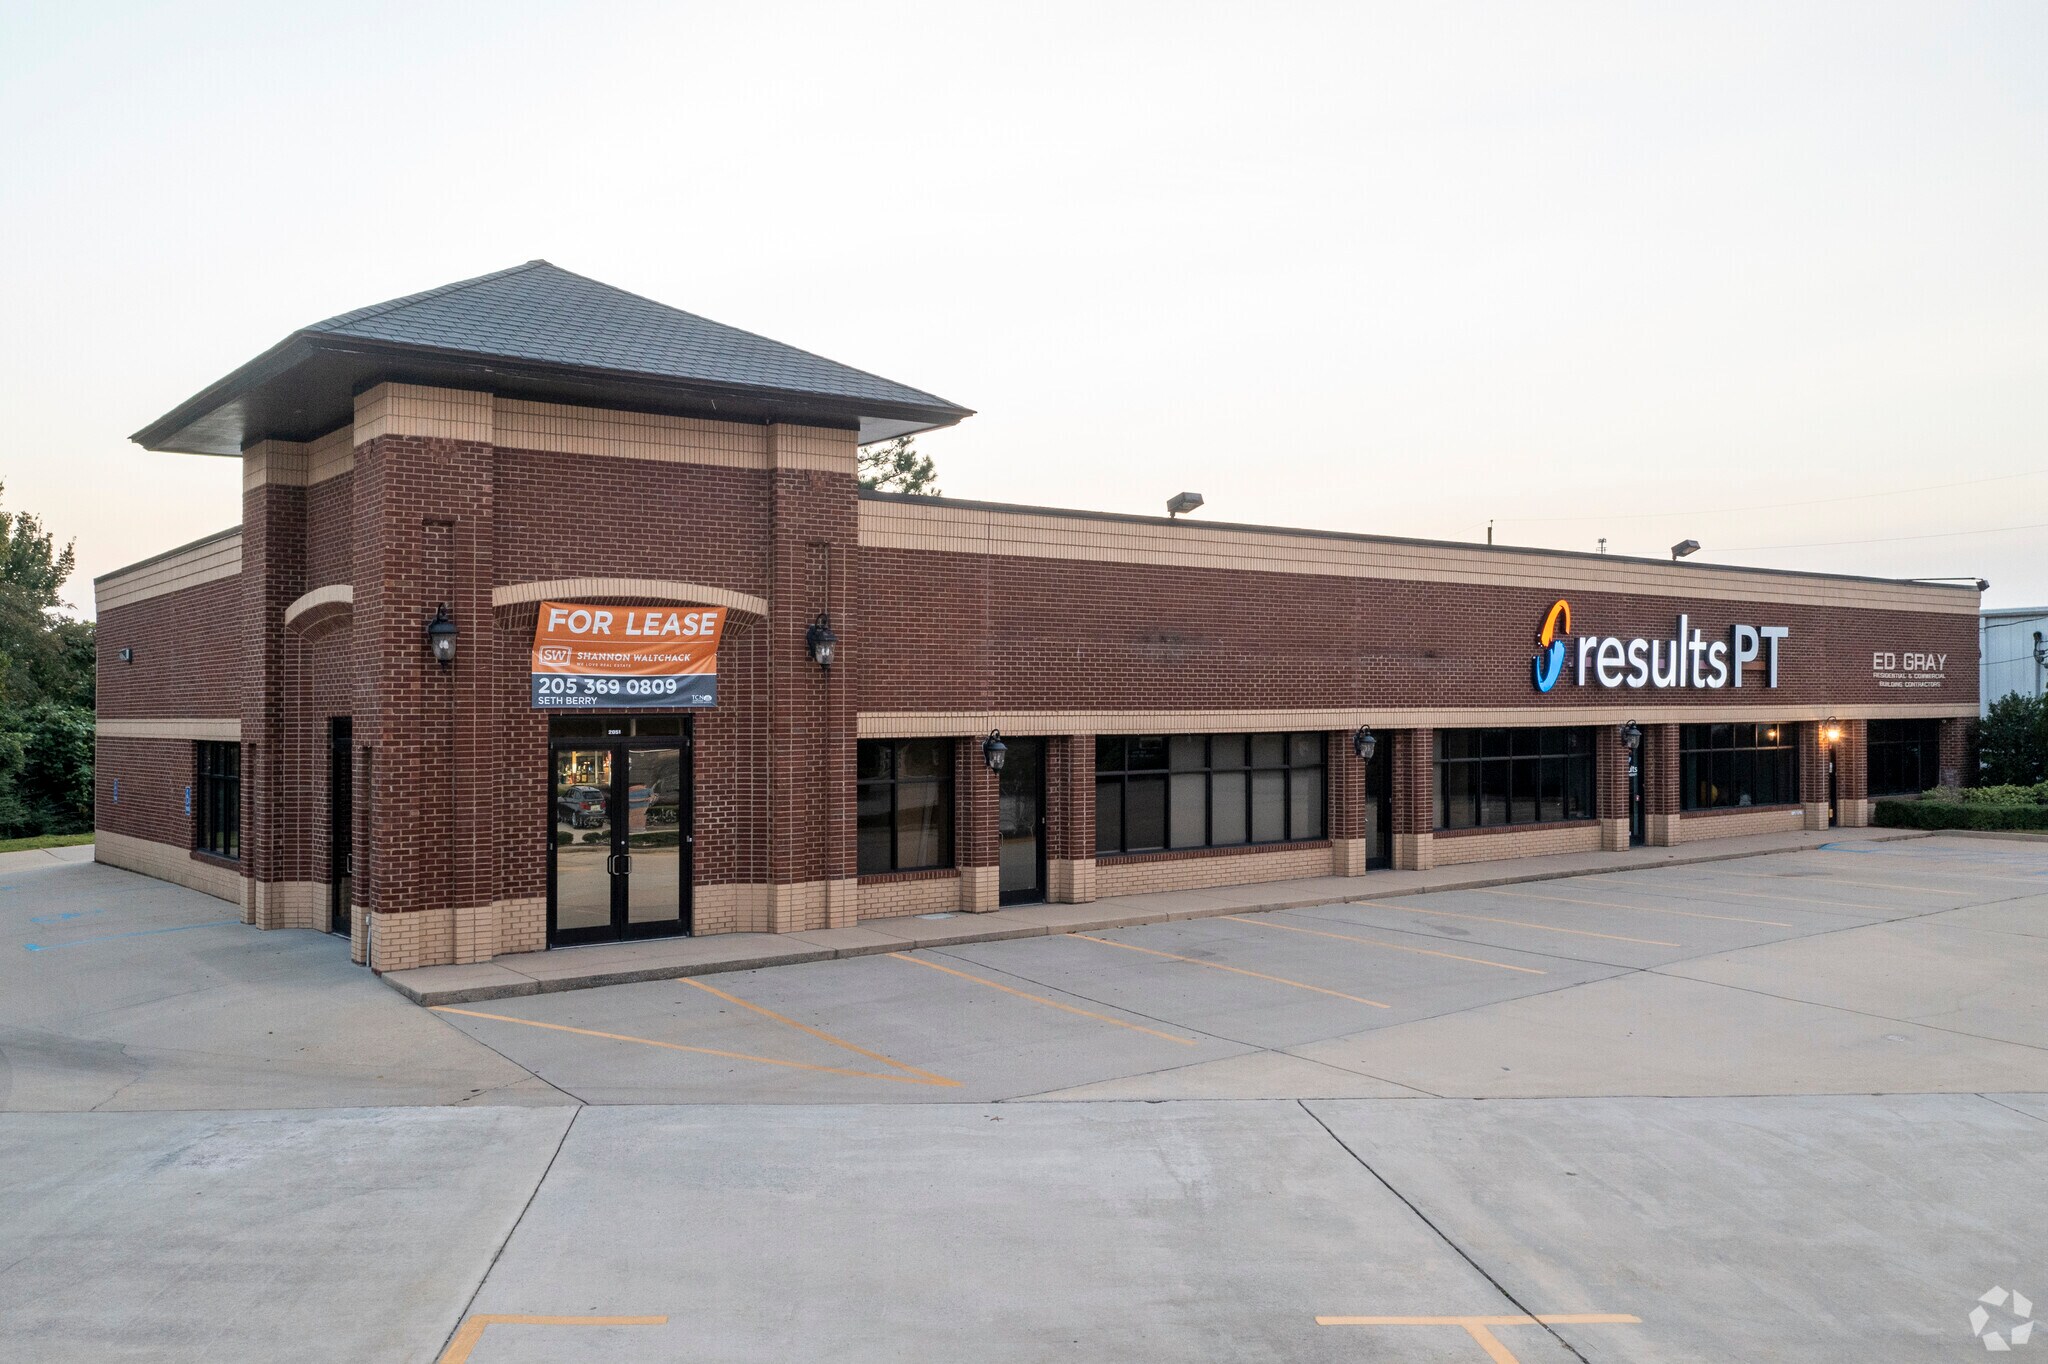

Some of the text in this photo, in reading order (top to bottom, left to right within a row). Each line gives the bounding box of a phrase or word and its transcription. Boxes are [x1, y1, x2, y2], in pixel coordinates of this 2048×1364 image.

[547, 608, 718, 636] FOR LEASE
[543, 649, 567, 661] SW
[577, 651, 691, 662] SHANNON WALTCHACK
[1873, 652, 1947, 671] ED GRAY
[538, 678, 677, 695] 205 369 0809
[538, 696, 598, 705] SETH BERRY
